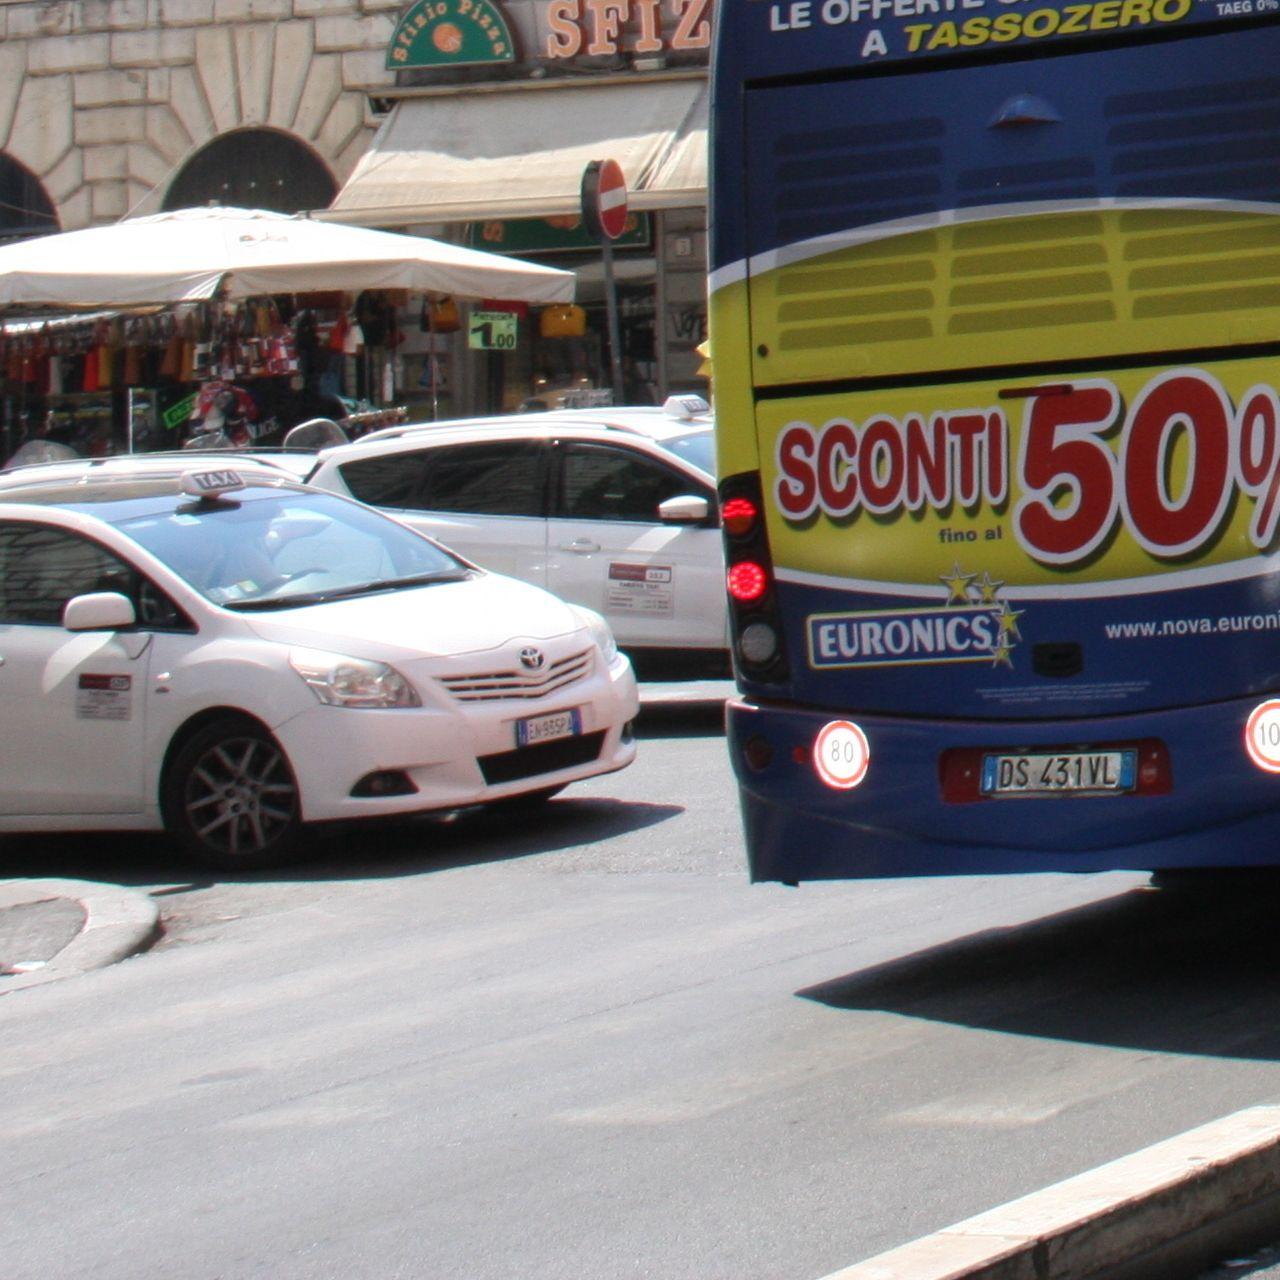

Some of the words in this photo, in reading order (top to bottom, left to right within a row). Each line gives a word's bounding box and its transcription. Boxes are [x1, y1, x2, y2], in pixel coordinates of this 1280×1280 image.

[770, 1, 812, 32] LE
[1216, 0, 1252, 16] TAEG
[861, 28, 888, 58] A
[774, 407, 1008, 521] SCONTI
[194, 471, 241, 488] TAXI
[939, 527, 978, 543] fino
[985, 524, 1003, 540] al
[819, 614, 993, 657] EURONICS
[831, 738, 854, 763] 80
[1000, 757, 1029, 788] DS
[1041, 756, 1117, 788] 431VL
